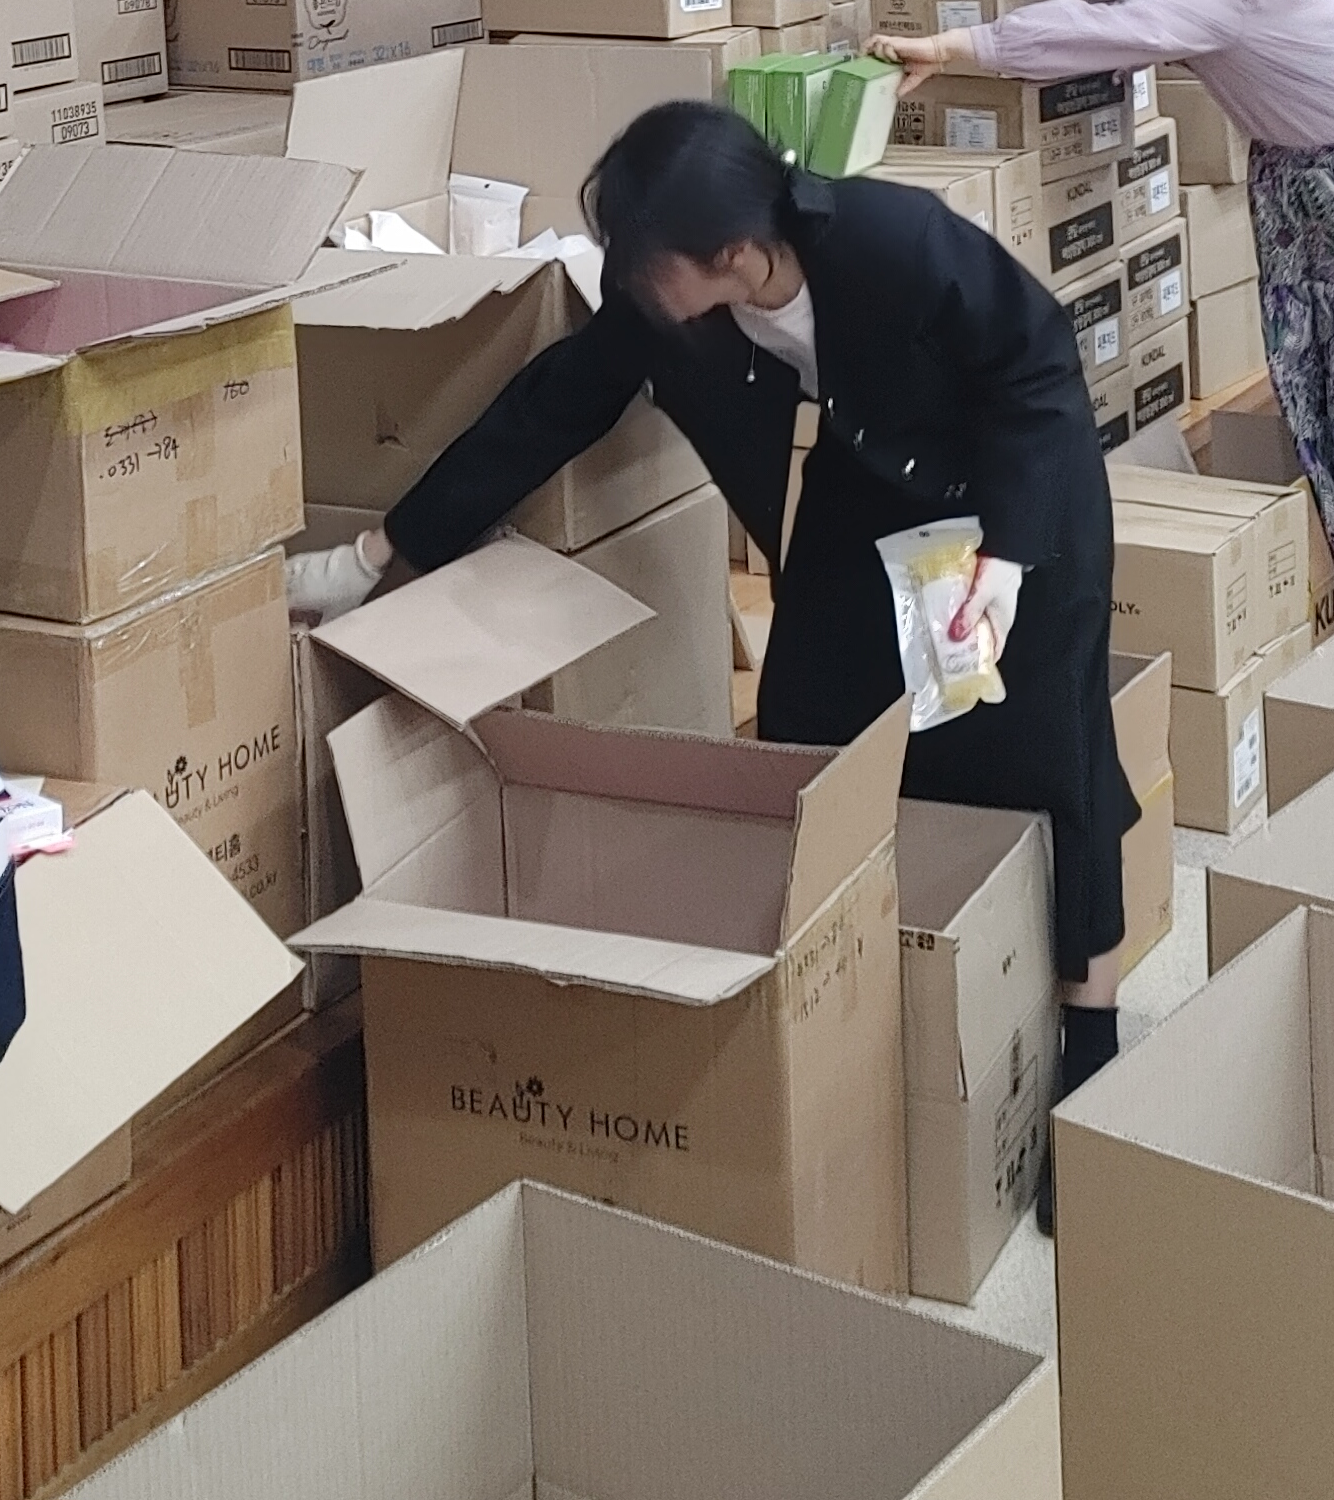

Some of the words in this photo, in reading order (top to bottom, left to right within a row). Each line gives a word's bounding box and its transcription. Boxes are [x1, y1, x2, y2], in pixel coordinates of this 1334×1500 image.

[50, 101, 98, 123] 11038935
[60, 121, 90, 139] 09073
[164, 764, 208, 809] UTY
[218, 723, 281, 782] HOME
[450, 1084, 574, 1132] BEAUTY
[588, 1106, 690, 1152] HOME
